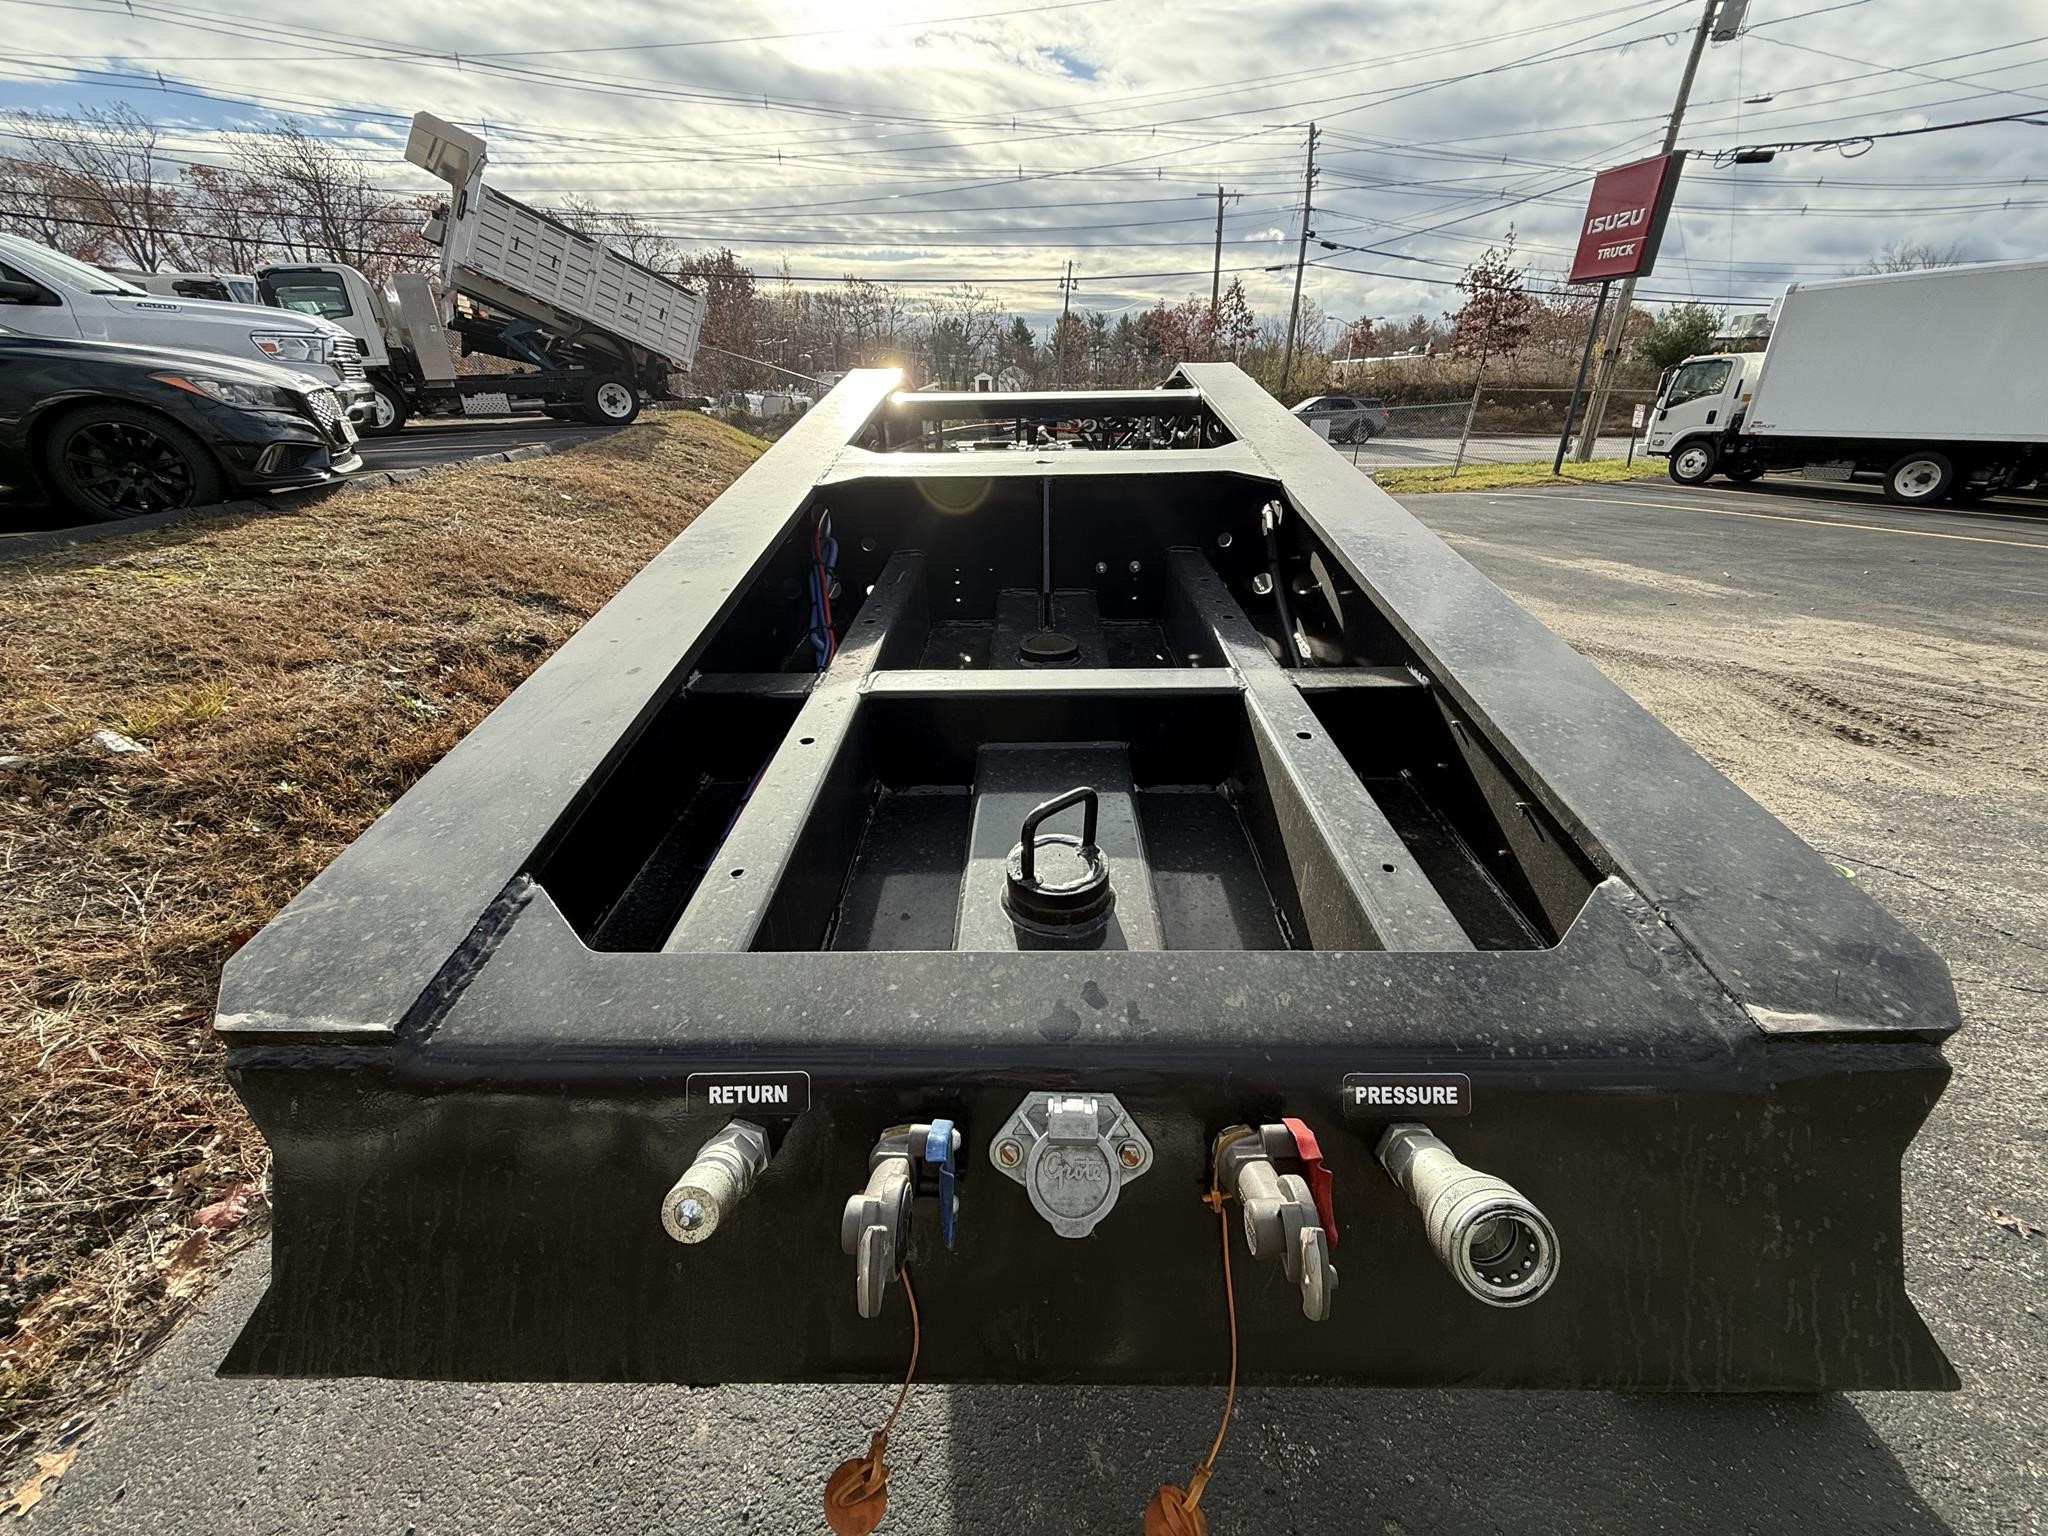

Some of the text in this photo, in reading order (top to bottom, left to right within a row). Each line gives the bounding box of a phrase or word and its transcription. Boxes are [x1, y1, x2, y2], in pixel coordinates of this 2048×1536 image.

[1586, 207, 1646, 235] ISUZU
[1597, 243, 1636, 260] TRUCK
[708, 1085, 788, 1104] RETURN
[1355, 1086, 1458, 1105] PRESSURE
[1043, 1151, 1104, 1190] Grote
